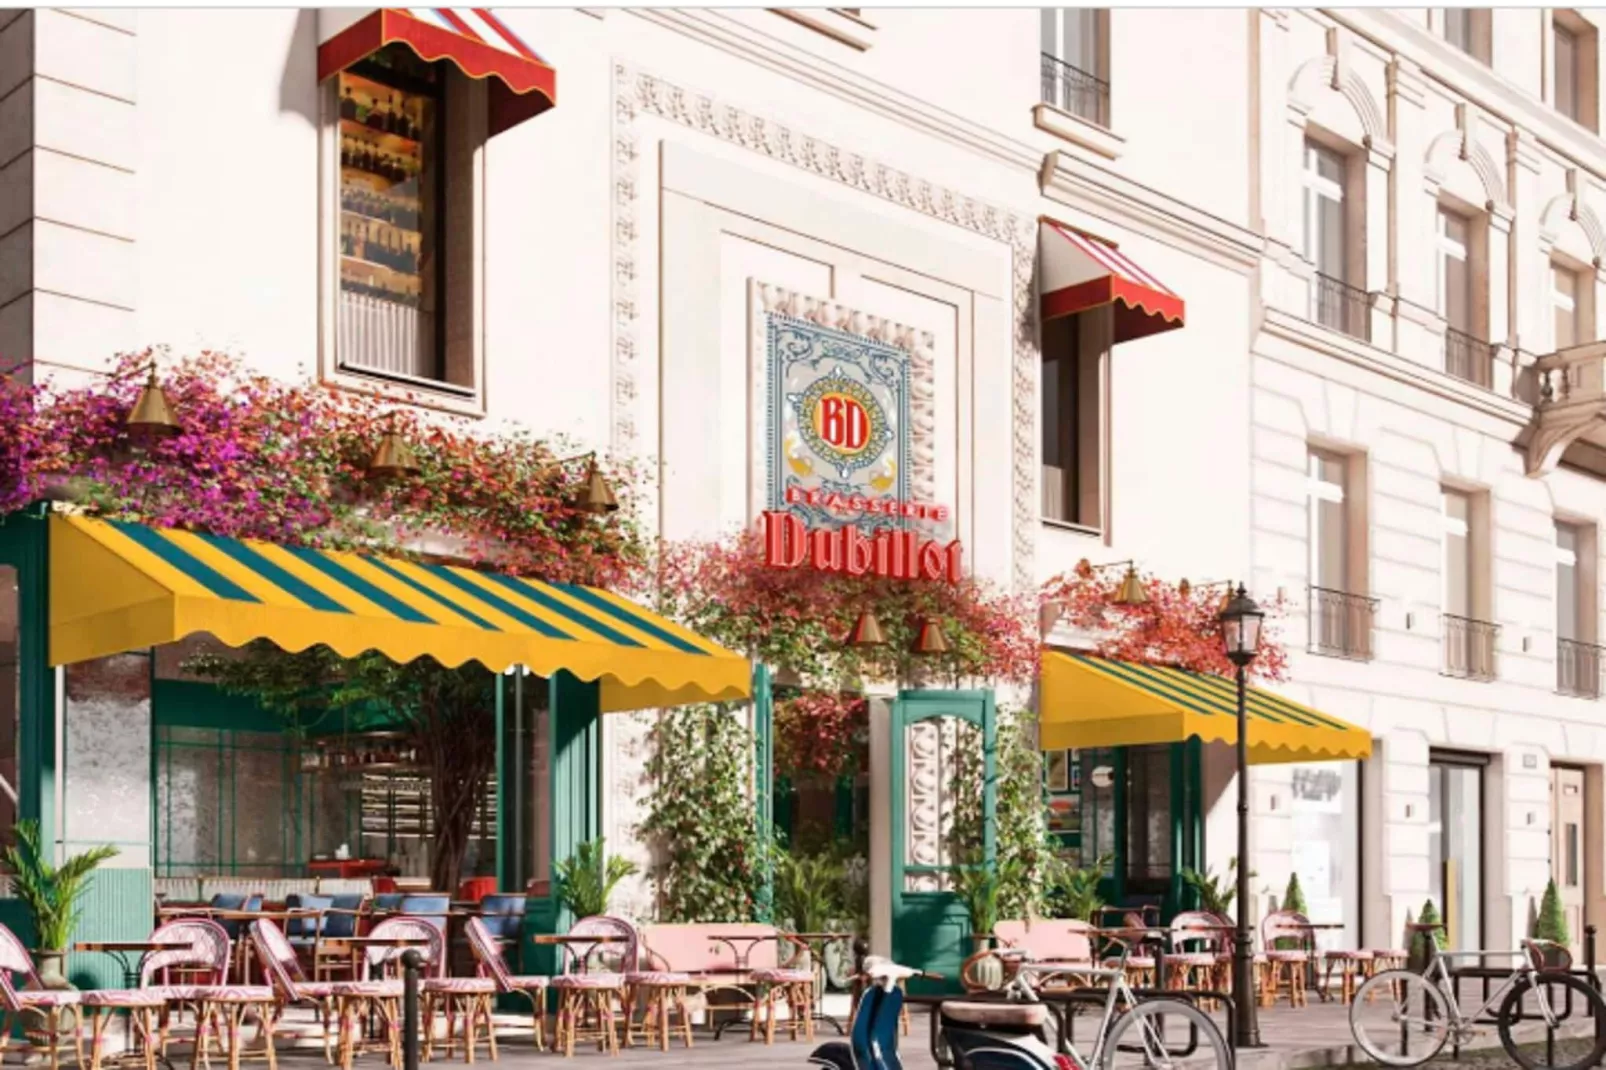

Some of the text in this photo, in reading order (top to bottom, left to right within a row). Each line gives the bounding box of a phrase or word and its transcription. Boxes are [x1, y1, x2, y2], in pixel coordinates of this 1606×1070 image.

[821, 396, 869, 449] BD
[786, 486, 949, 522] BRASSERIE
[762, 511, 963, 585] Dubillot
